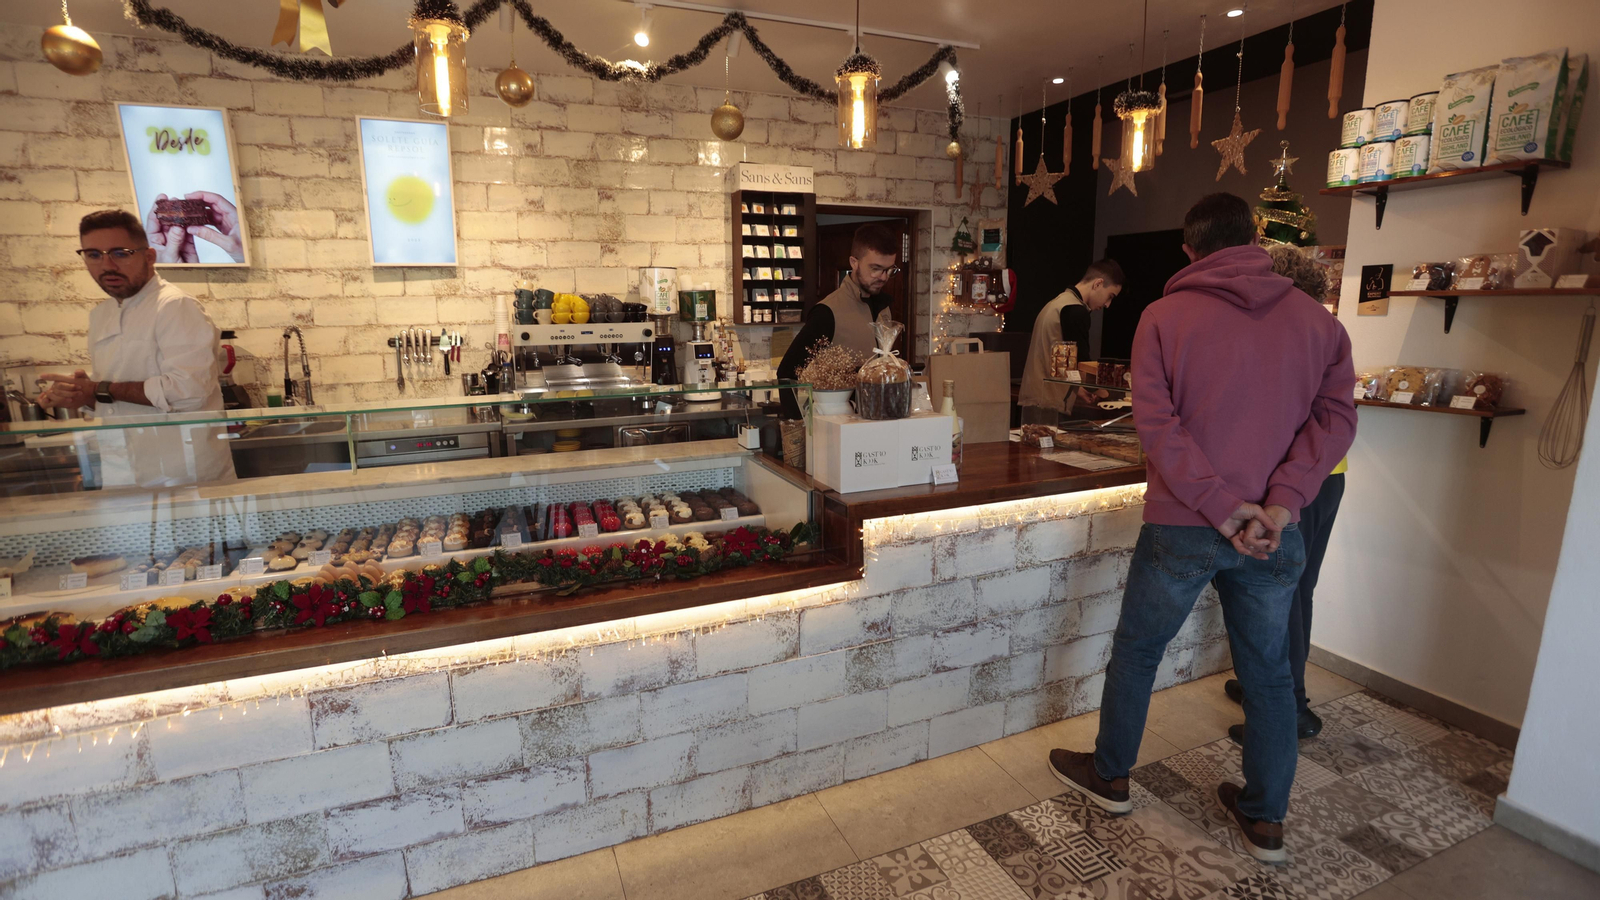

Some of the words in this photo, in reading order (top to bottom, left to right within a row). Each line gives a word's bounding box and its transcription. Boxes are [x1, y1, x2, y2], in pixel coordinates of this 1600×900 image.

[1501, 110, 1534, 128] CAFÉ
[1442, 120, 1470, 138] CAFÉ
[155, 127, 204, 152] Desde
[741, 169, 771, 184] Sans
[772, 172, 783, 185] &
[784, 172, 813, 186] Sans
